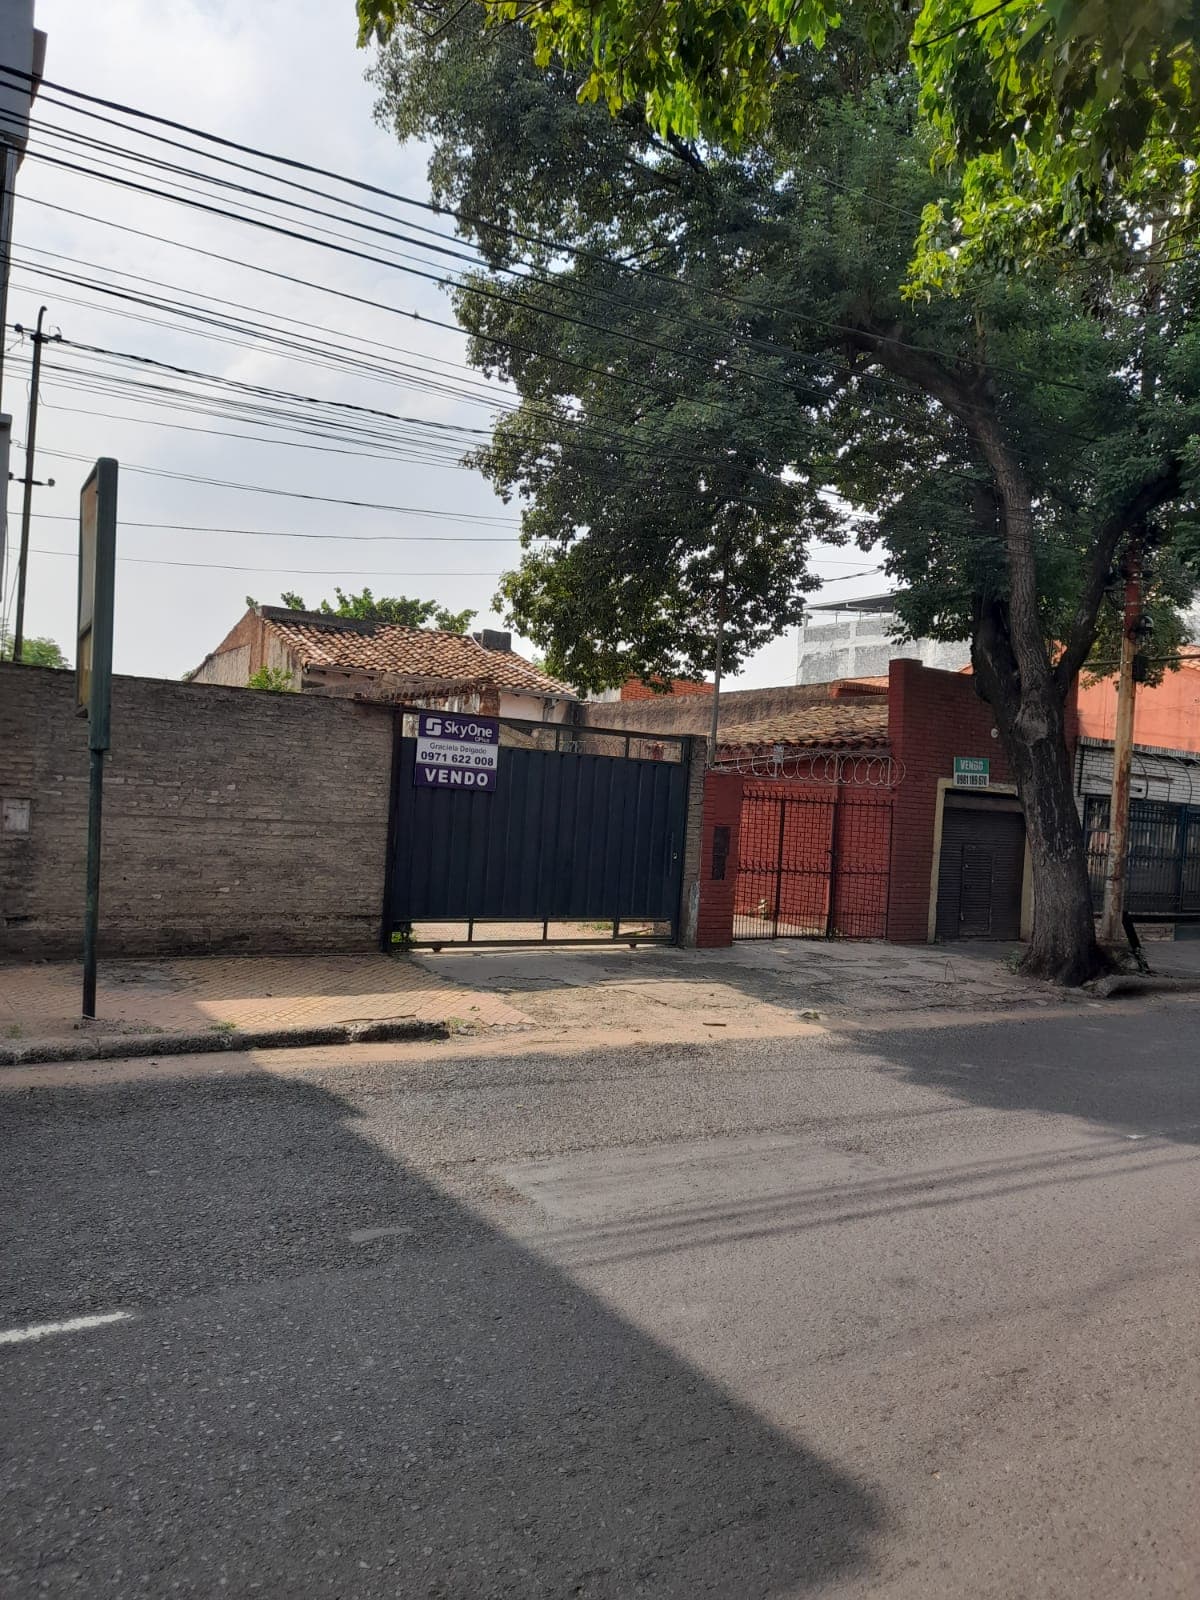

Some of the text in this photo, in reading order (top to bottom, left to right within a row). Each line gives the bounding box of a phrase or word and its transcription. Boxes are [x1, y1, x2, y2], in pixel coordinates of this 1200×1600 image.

[444, 720, 493, 738] SkyOne
[429, 742, 487, 755] Graciela Delgado
[421, 751, 494, 767] 0971 622 008
[425, 768, 488, 786] VENDO
